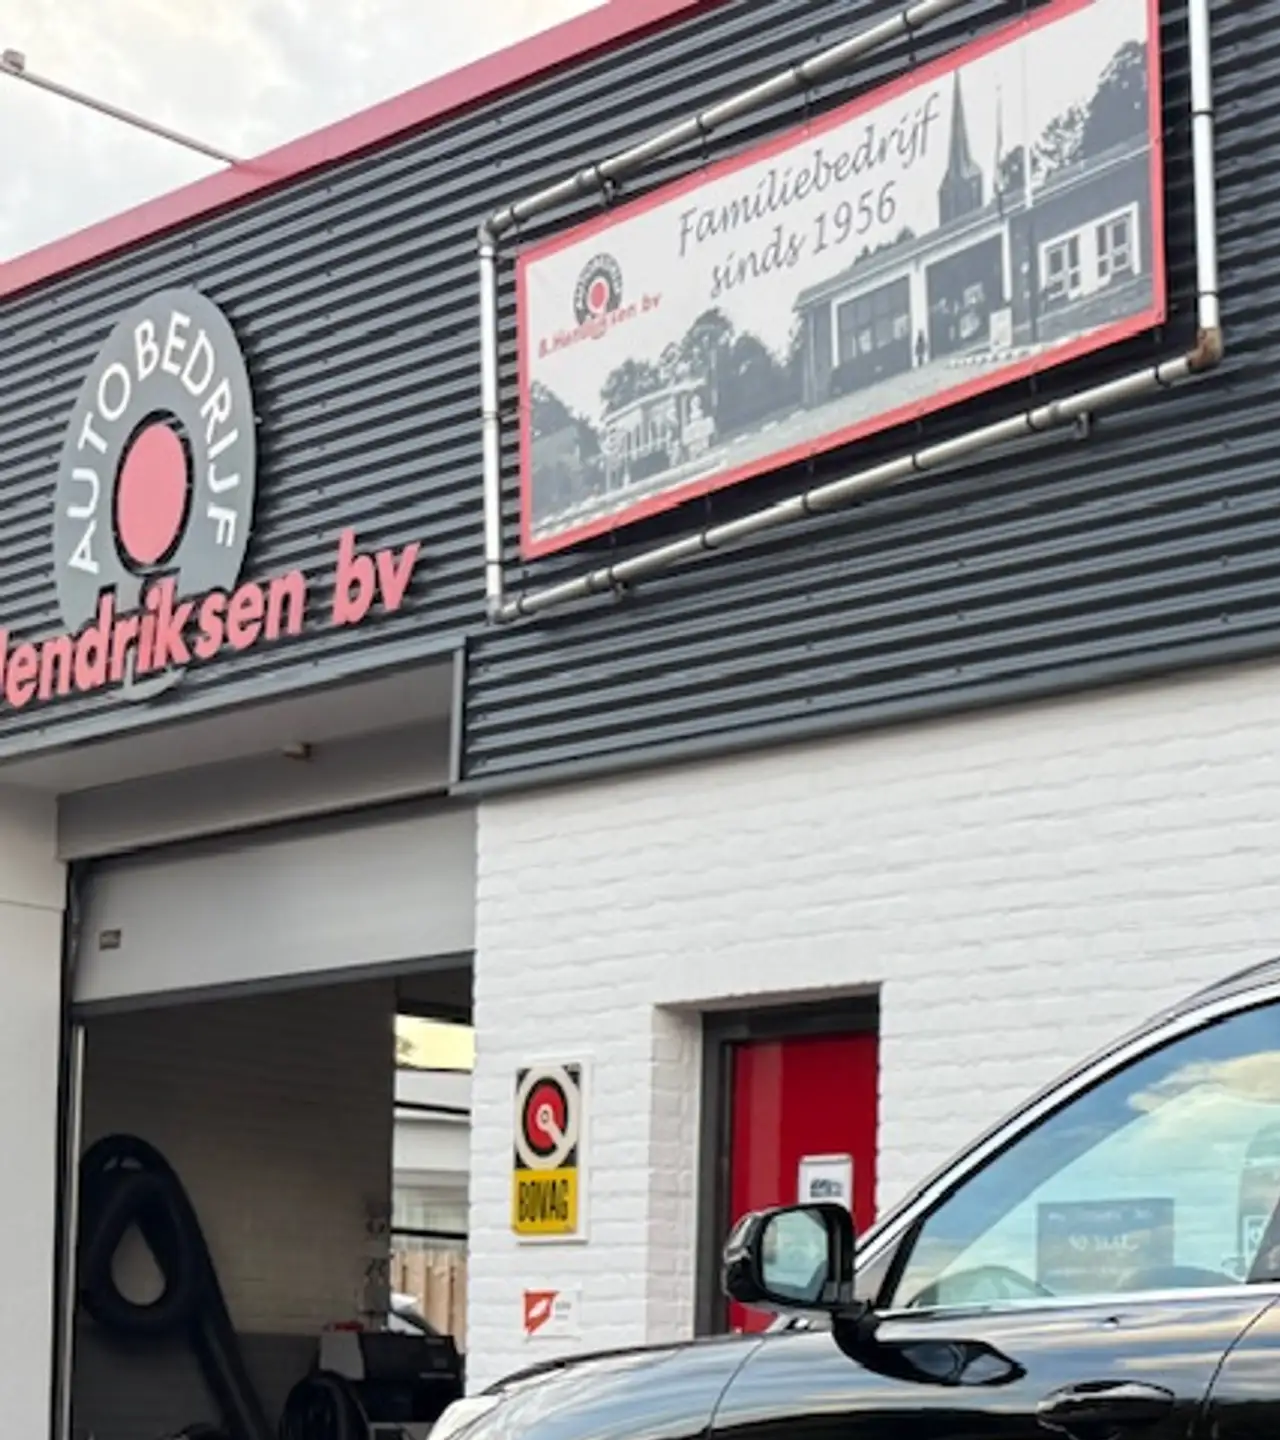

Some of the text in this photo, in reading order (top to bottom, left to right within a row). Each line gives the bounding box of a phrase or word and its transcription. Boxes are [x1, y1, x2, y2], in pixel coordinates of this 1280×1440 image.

[679, 91, 941, 257] Familiebedrijf
[710, 223, 806, 298] sinds
[812, 180, 897, 255] 1956
[67, 311, 240, 575] AUTOBEDRIJF
[0, 526, 421, 708] endriksen bv
[518, 1179, 569, 1223] BOVAG
